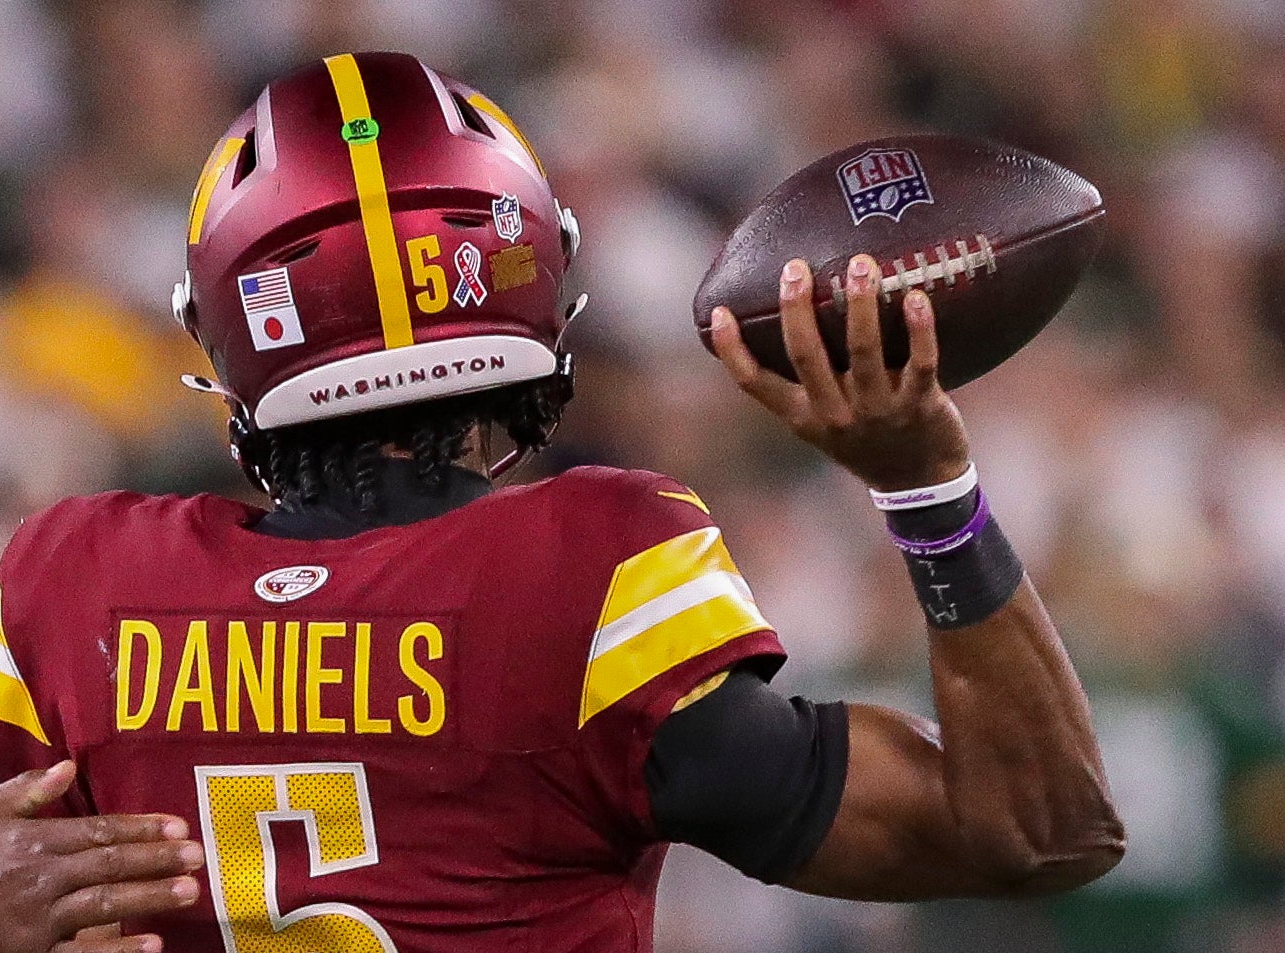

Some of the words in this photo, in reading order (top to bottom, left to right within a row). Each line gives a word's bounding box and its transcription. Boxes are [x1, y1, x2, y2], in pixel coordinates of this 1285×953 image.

[844, 151, 915, 189] NFL
[406, 235, 449, 313] 5
[308, 355, 506, 406] WASHINGTON
[116, 619, 446, 737] DANIELS
